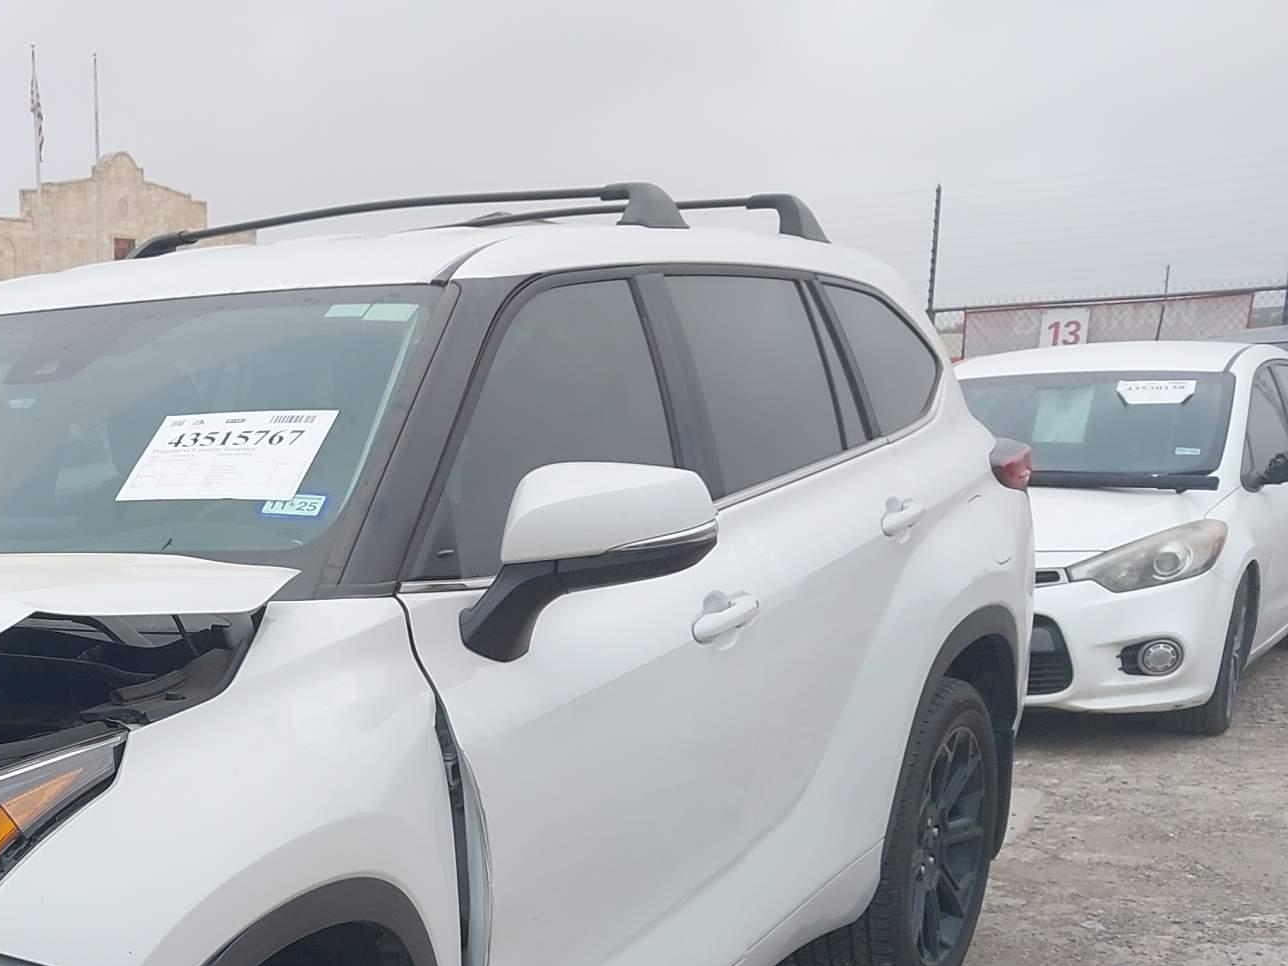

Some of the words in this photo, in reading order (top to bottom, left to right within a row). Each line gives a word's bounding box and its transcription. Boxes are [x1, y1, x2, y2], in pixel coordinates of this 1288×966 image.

[1047, 319, 1081, 347] 13
[167, 429, 307, 448] 43515767
[295, 501, 319, 512] 25
